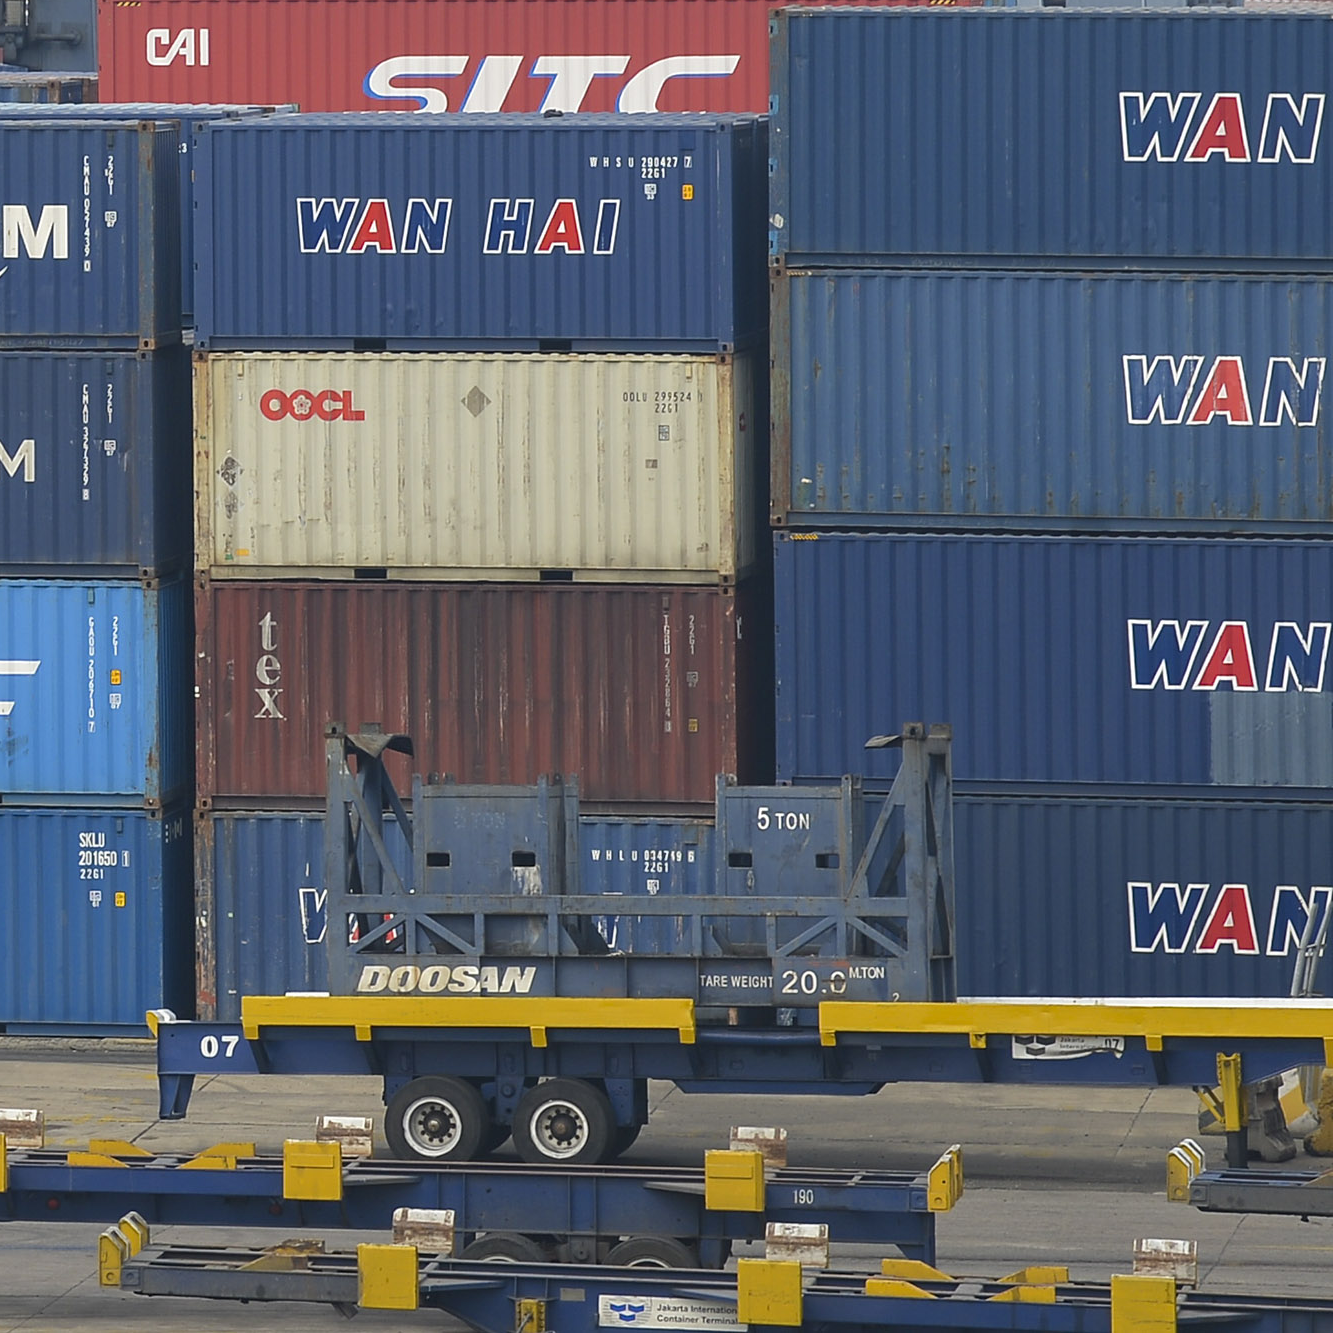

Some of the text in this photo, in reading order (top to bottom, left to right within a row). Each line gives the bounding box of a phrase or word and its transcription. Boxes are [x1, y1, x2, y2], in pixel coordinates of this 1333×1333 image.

[147, 29, 740, 114] CAI SITC
[1119, 92, 1325, 163] WAN
[297, 198, 620, 254] WAN HAI
[655, 392, 691, 405] 299524
[1123, 355, 1326, 426] WAN
[261, 390, 365, 420] OOCL
[255, 612, 286, 720] tex
[1128, 620, 1331, 692] WAN
[758, 808, 809, 829] 5 TON
[80, 833, 104, 847] SKLU
[79, 851, 117, 866] 201650
[1128, 882, 1333, 959] WAN
[358, 966, 536, 992] DOOSAN
[701, 967, 884, 995] TARE WEIGHT 20.0 M.TON
[201, 1036, 238, 1057] 07
[795, 1189, 813, 1204] 190
[655, 1304, 736, 1317] Jakarta Internation
[657, 1315, 737, 1326] Container Terminal
